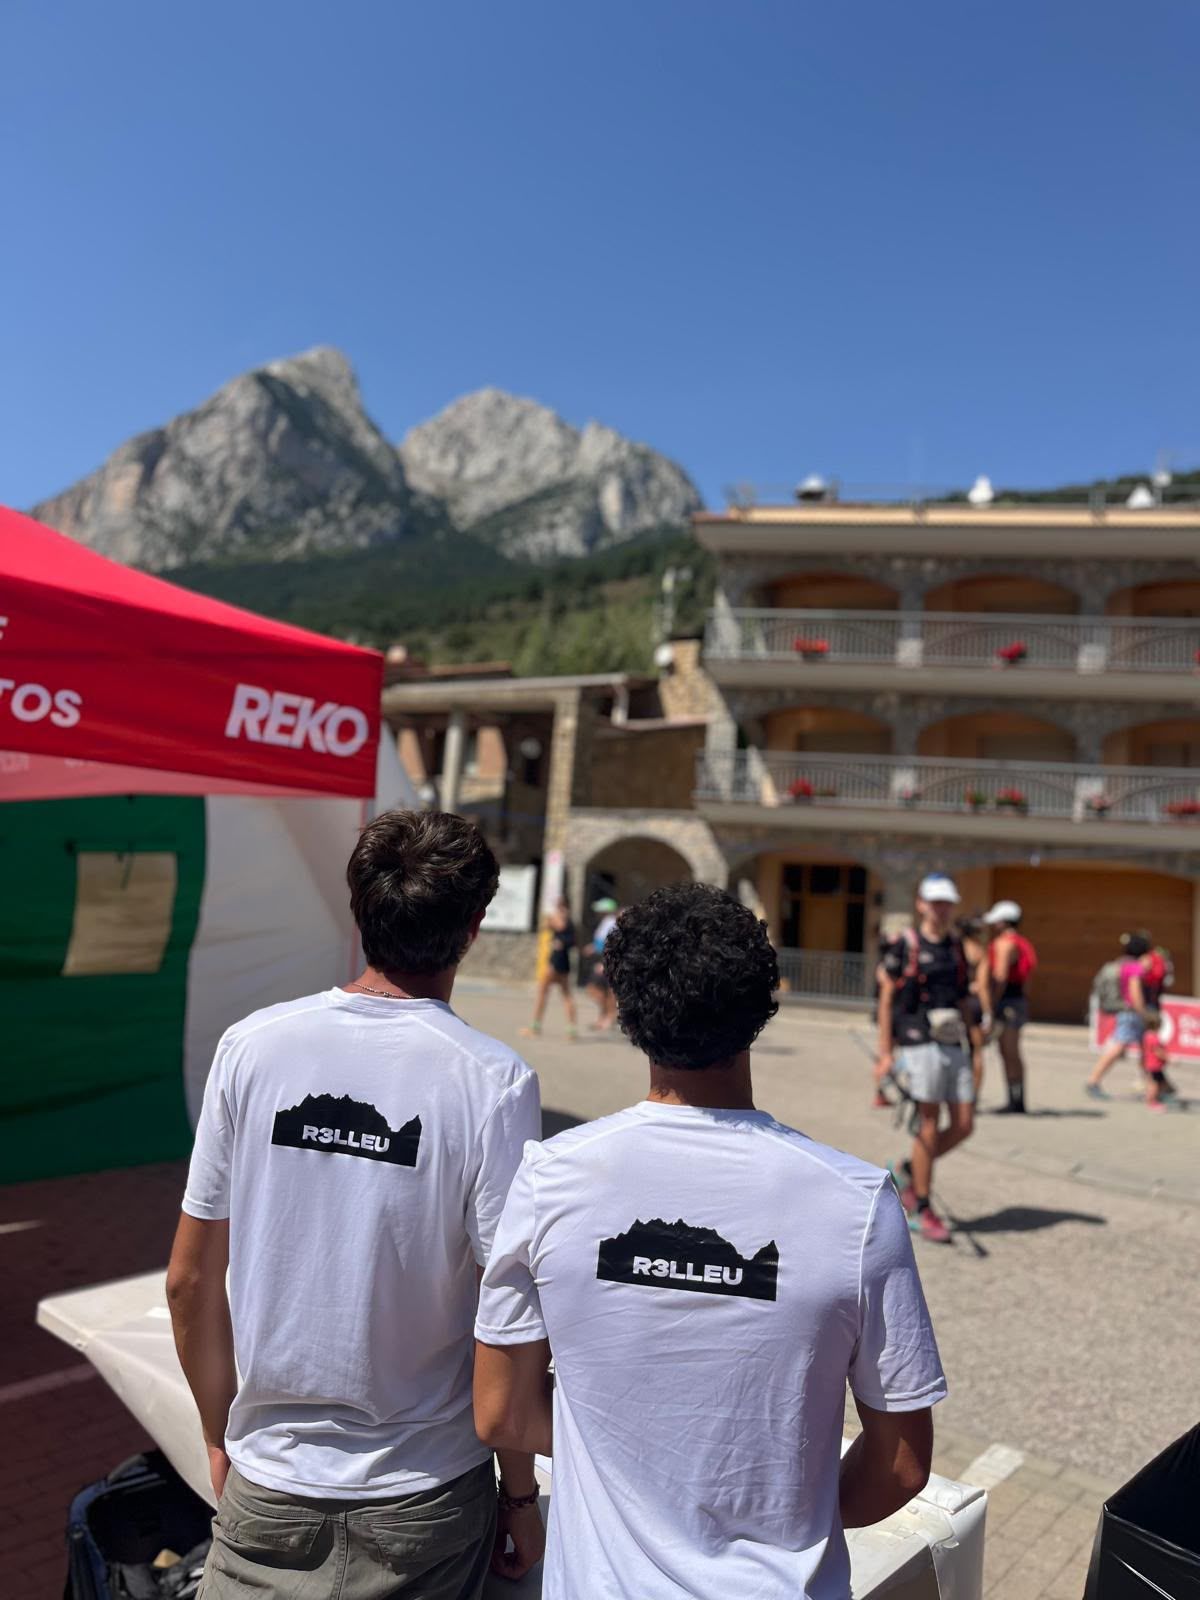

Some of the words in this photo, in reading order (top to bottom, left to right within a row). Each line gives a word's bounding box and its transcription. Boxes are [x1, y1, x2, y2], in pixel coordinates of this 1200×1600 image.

[225, 682, 369, 758] REKO
[302, 1124, 390, 1152] R3LLEU
[632, 1255, 743, 1286] R3LLEU
